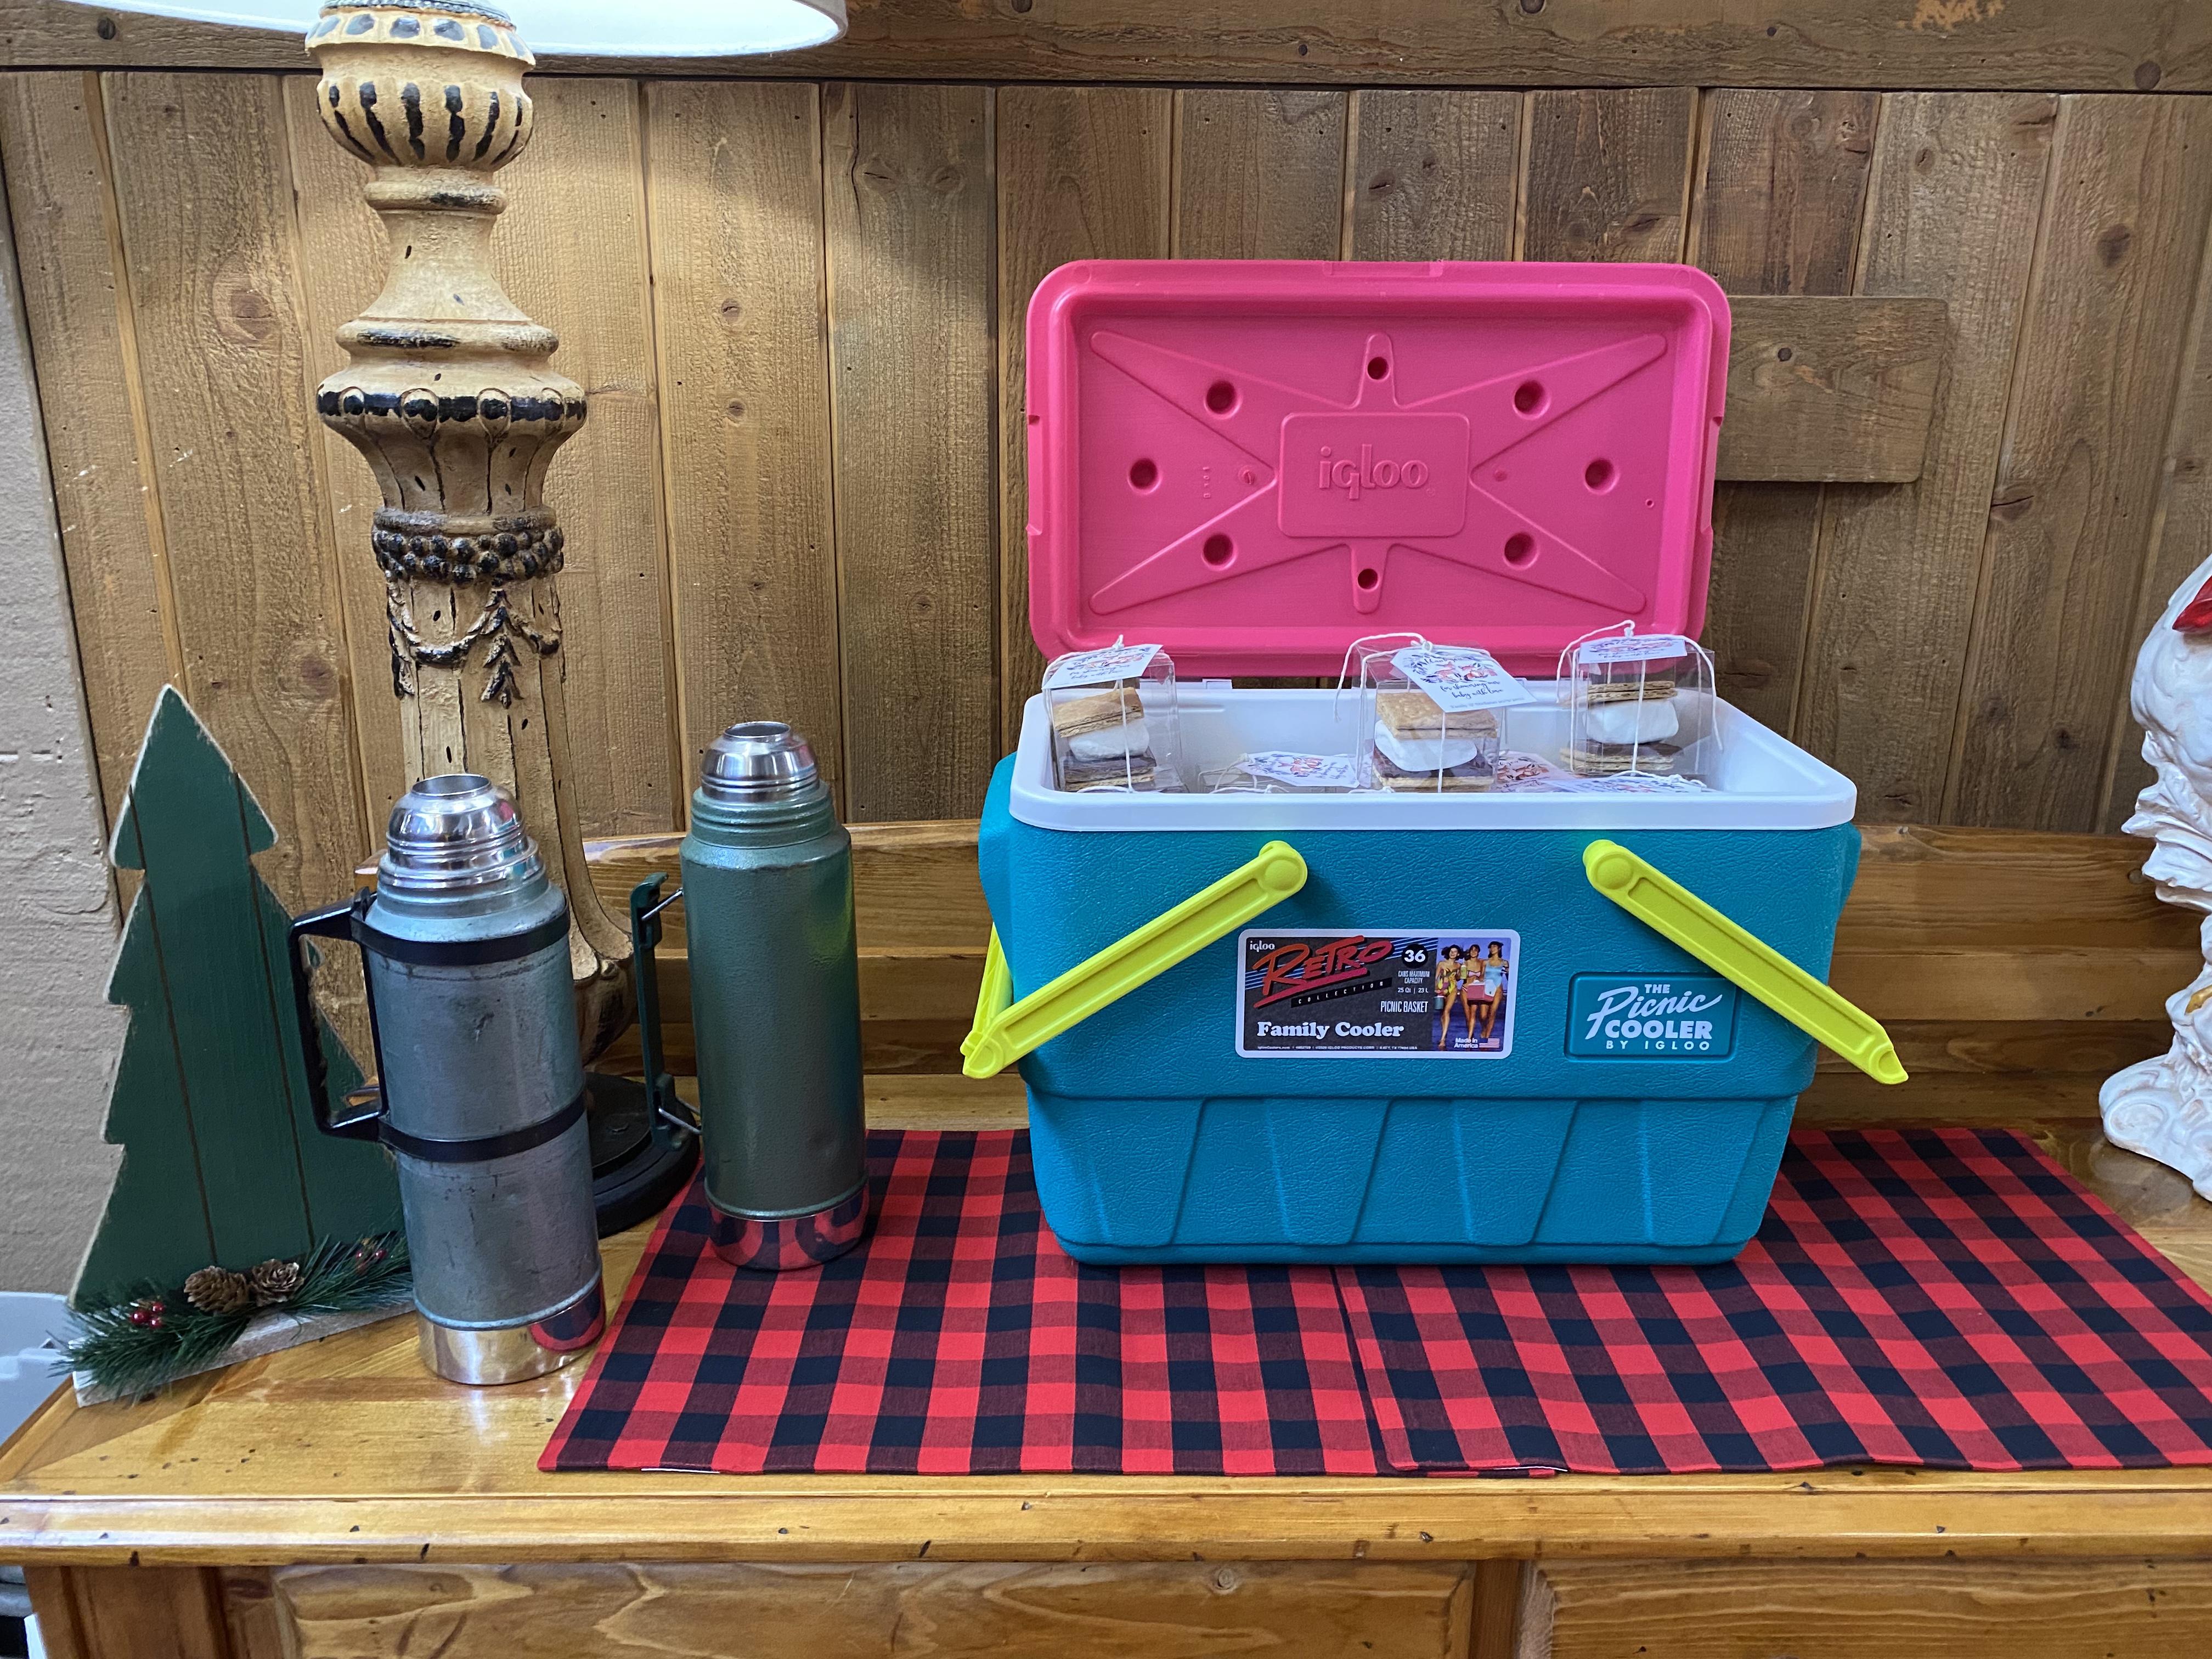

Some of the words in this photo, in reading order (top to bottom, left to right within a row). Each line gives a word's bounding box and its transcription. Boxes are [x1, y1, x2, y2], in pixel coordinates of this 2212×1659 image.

[1319, 444, 1429, 500] igloo
[1453, 682, 1488, 691] showering
[1452, 691, 1471, 699] baby
[1250, 940, 1276, 952] igloo
[1404, 950, 1426, 962] 36
[1298, 981, 1383, 1005] COLLECTION
[1645, 984, 1671, 994] THE
[1380, 1001, 1402, 1013] PICNIC
[1403, 1001, 1429, 1013] BASKET
[1585, 986, 1723, 1040] Picnic
[1257, 1021, 1330, 1040] Family
[1335, 1022, 1404, 1037] Cooler
[1605, 1019, 1712, 1040] COOLER
[1606, 1040, 1629, 1049] BY
[1645, 1040, 1709, 1051] IGLOO
